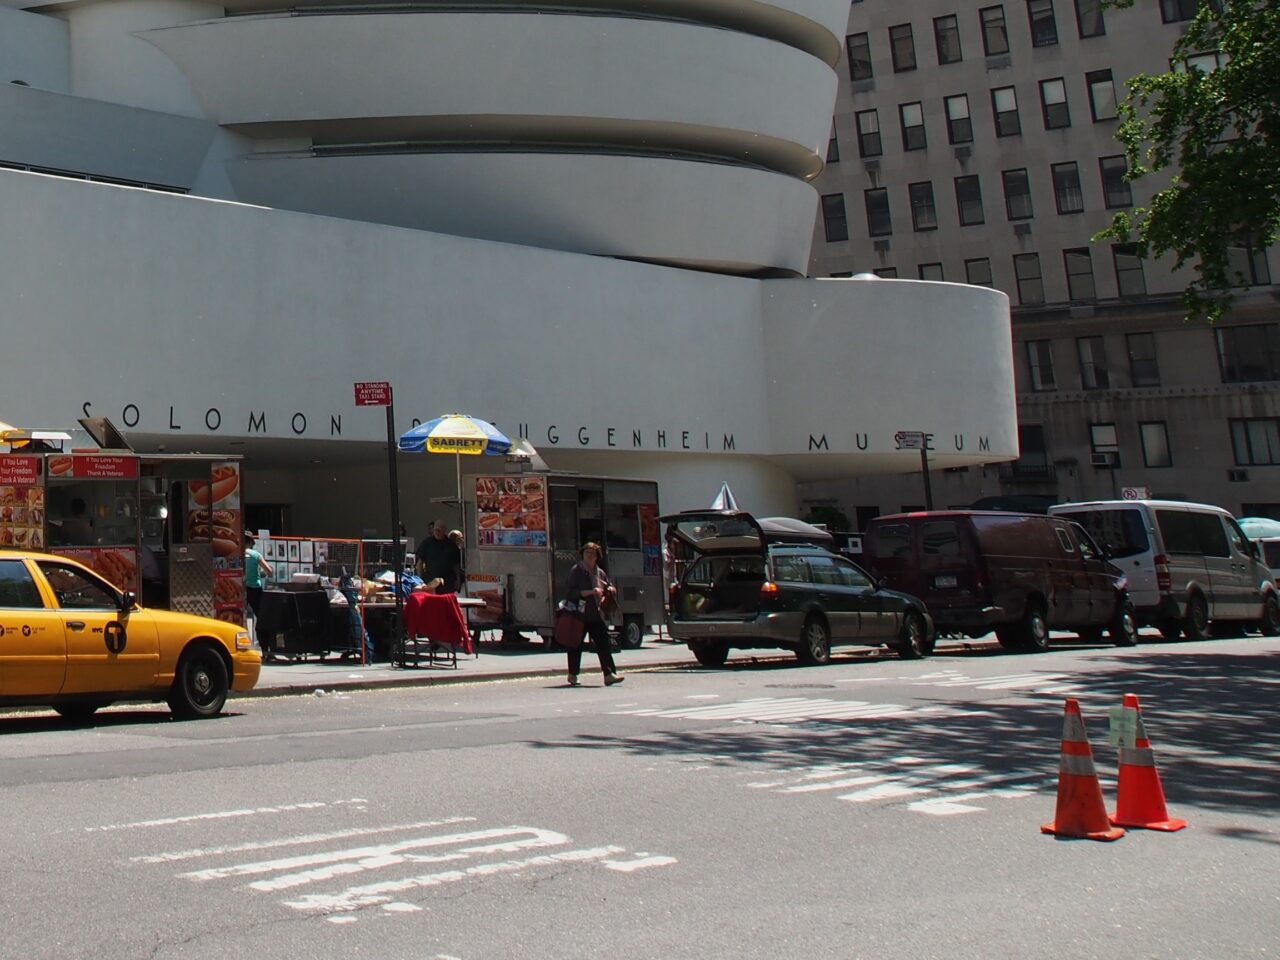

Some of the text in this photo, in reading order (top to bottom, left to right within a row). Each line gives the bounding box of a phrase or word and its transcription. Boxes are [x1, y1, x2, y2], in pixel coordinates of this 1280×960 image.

[491, 421, 737, 451] UGGENHEIM
[432, 438, 483, 447] SABRETT
[7, 457, 18, 465] You
[19, 457, 28, 466] Love
[11, 467, 33, 475] Freedom
[17, 476, 35, 484] Veteran
